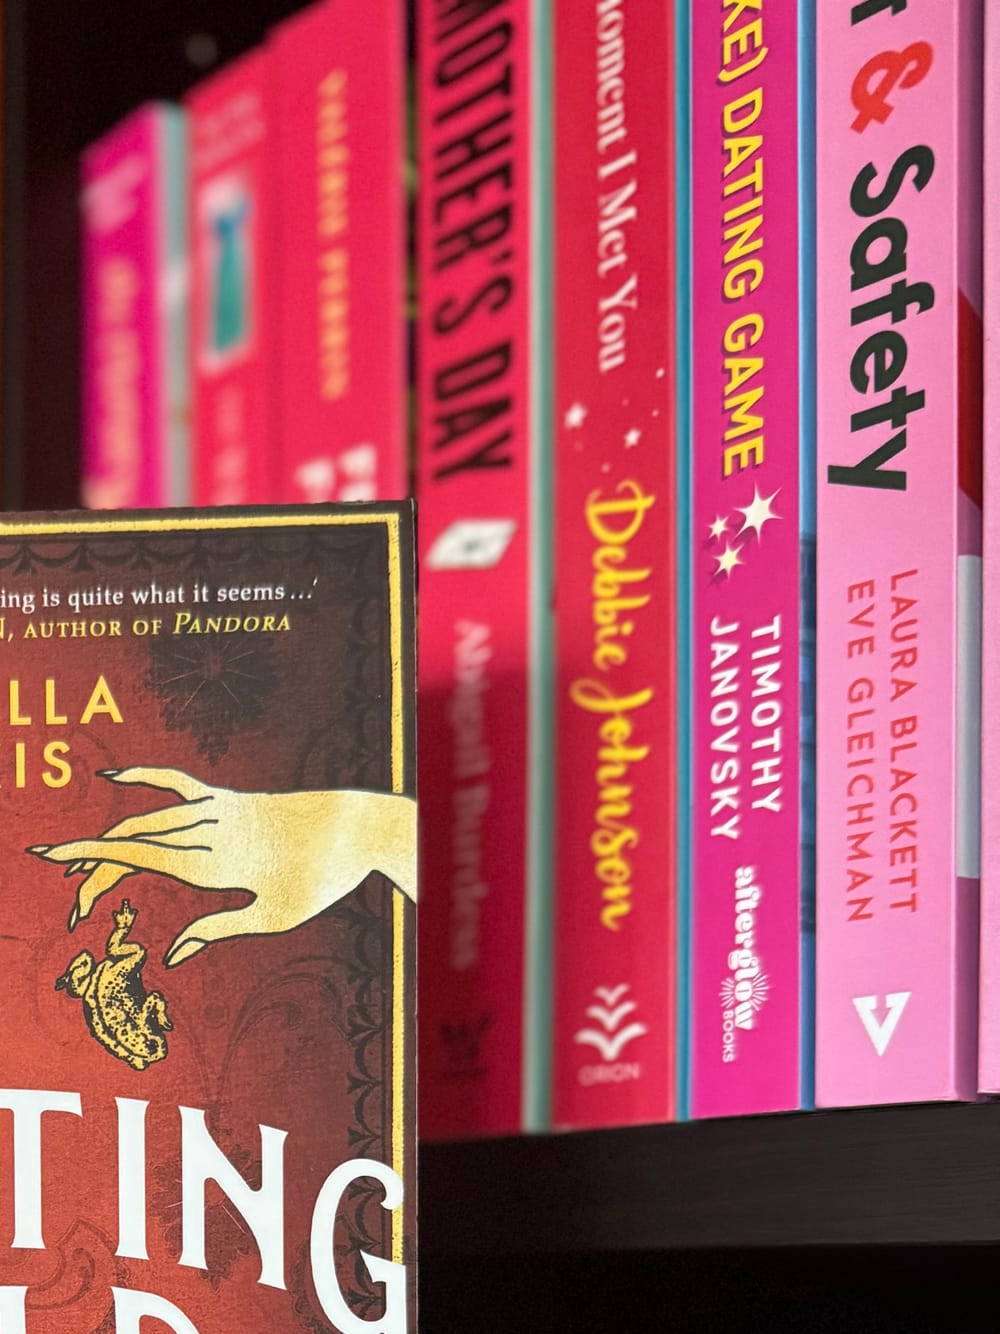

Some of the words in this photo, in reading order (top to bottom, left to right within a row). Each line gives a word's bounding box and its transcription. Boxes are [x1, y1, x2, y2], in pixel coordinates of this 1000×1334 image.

[849, 40, 934, 134] &
[597, 149, 637, 181] I
[597, 178, 637, 274] Met
[722, 87, 765, 300] DATING
[598, 275, 637, 374] You
[827, 144, 935, 491] Safety
[432, 339, 512, 483] DAY
[723, 313, 765, 477] GAME
[24, 621, 122, 639] AUTHOR
[132, 619, 163, 636] OF
[42, 585, 60, 607] is
[67, 585, 123, 613] quite
[131, 583, 185, 605] what
[192, 582, 209, 604] it
[584, 477, 656, 671] Debbie
[847, 579, 876, 660] EVE
[889, 568, 918, 702] LAURA
[710, 618, 740, 841] JANOVSKY
[751, 615, 781, 814] TIMOTHY
[570, 678, 653, 931] Johnson
[847, 678, 876, 924] GLEICHMAN
[889, 720, 918, 913] BLACKETT
[728, 866, 761, 1030] afterglow
[580, 1063, 640, 1086] ORION
[721, 1010, 735, 1064] BOOKS
